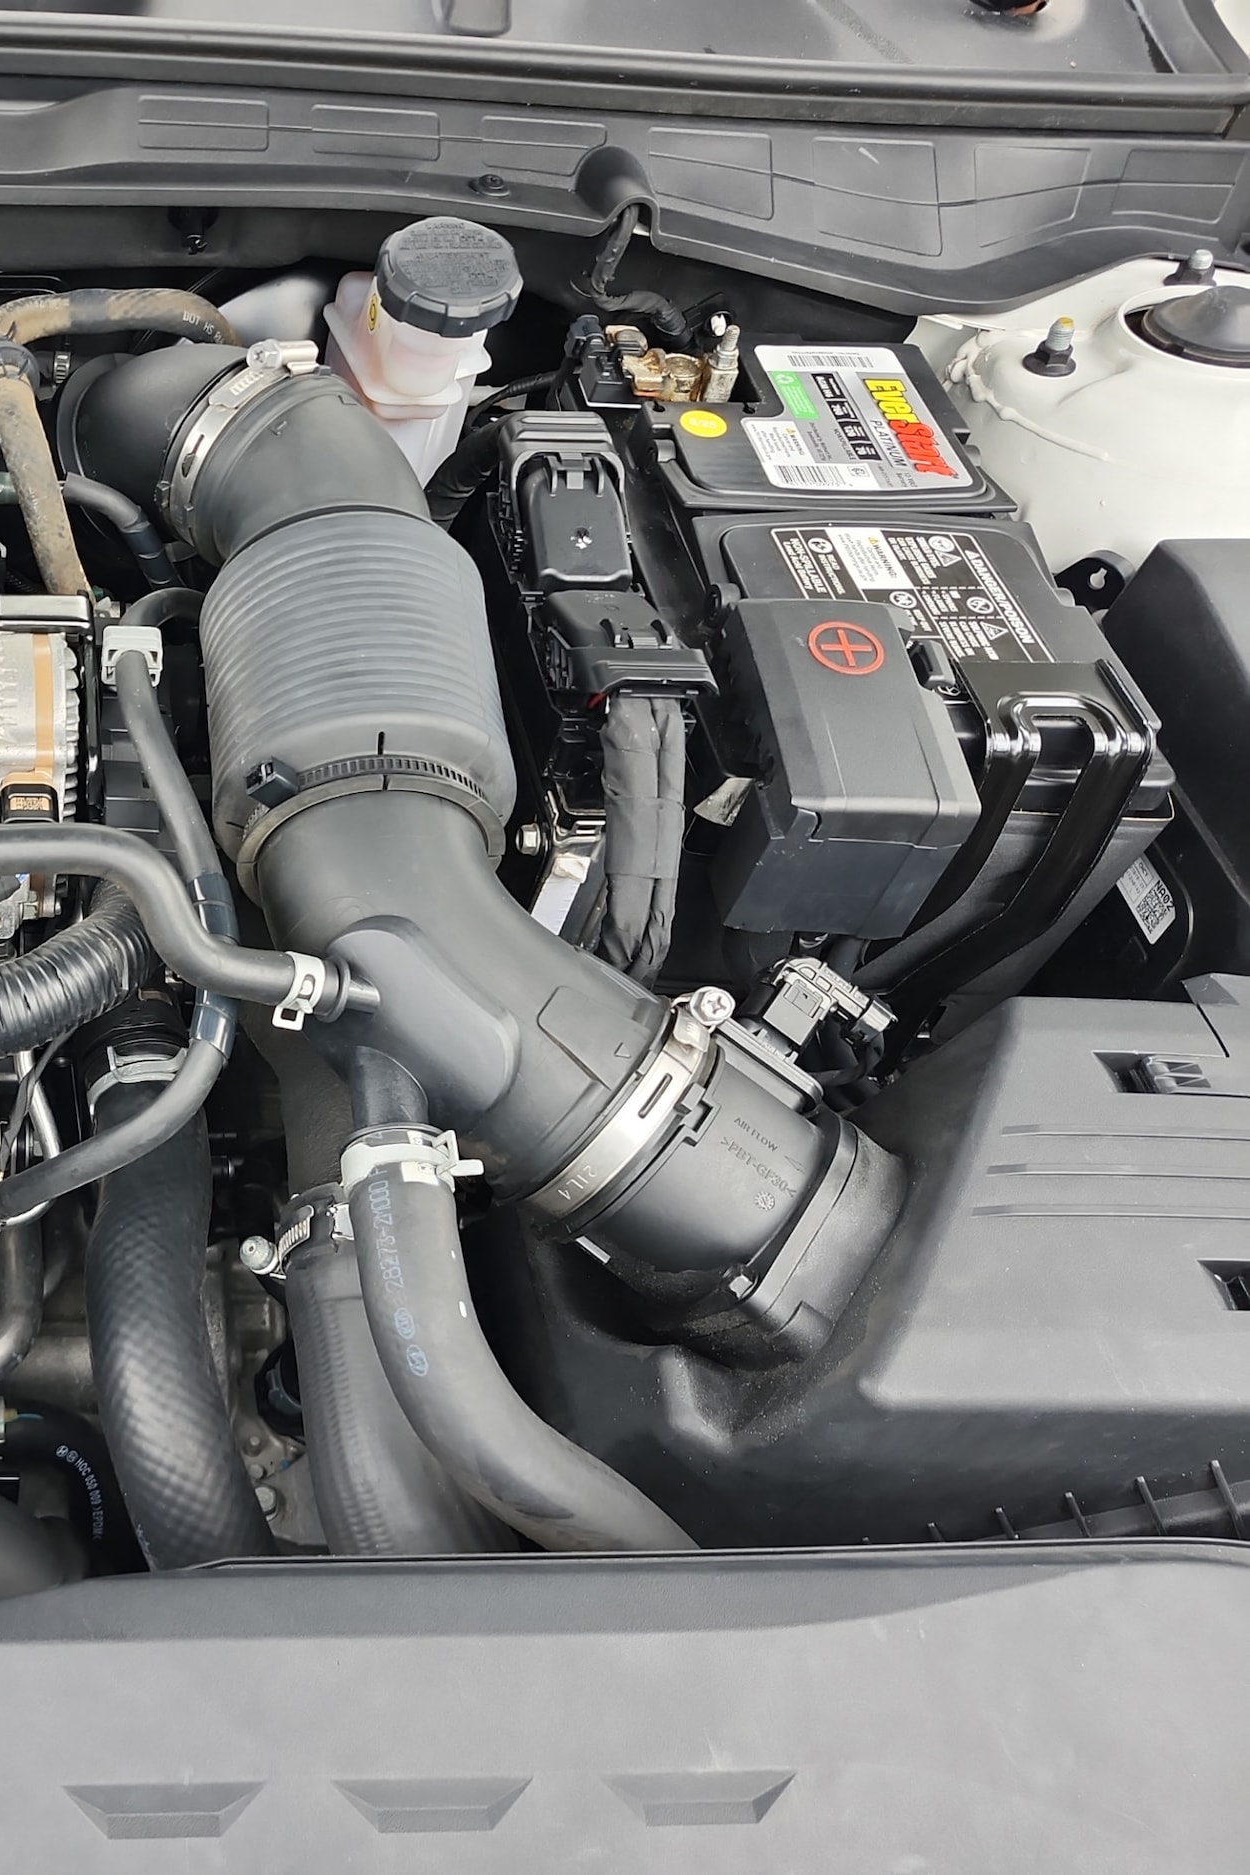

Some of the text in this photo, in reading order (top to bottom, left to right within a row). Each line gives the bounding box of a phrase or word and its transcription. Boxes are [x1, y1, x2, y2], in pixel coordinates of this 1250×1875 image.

[183, 310, 215, 335] DOT HS
[863, 378, 958, 476] EverStart
[870, 419, 907, 467] PLATINUM
[787, 538, 827, 592] NON-SPILLABLE
[825, 554, 841, 569] READ
[872, 544, 897, 578] WARNING:
[968, 559, 1035, 643] DANGER/POISON
[1153, 879, 1175, 912] NA02
[733, 1116, 779, 1152] AIR FLOW
[368, 1179, 404, 1294] 28273-2M000
[74, 1457, 91, 1477] HOC
